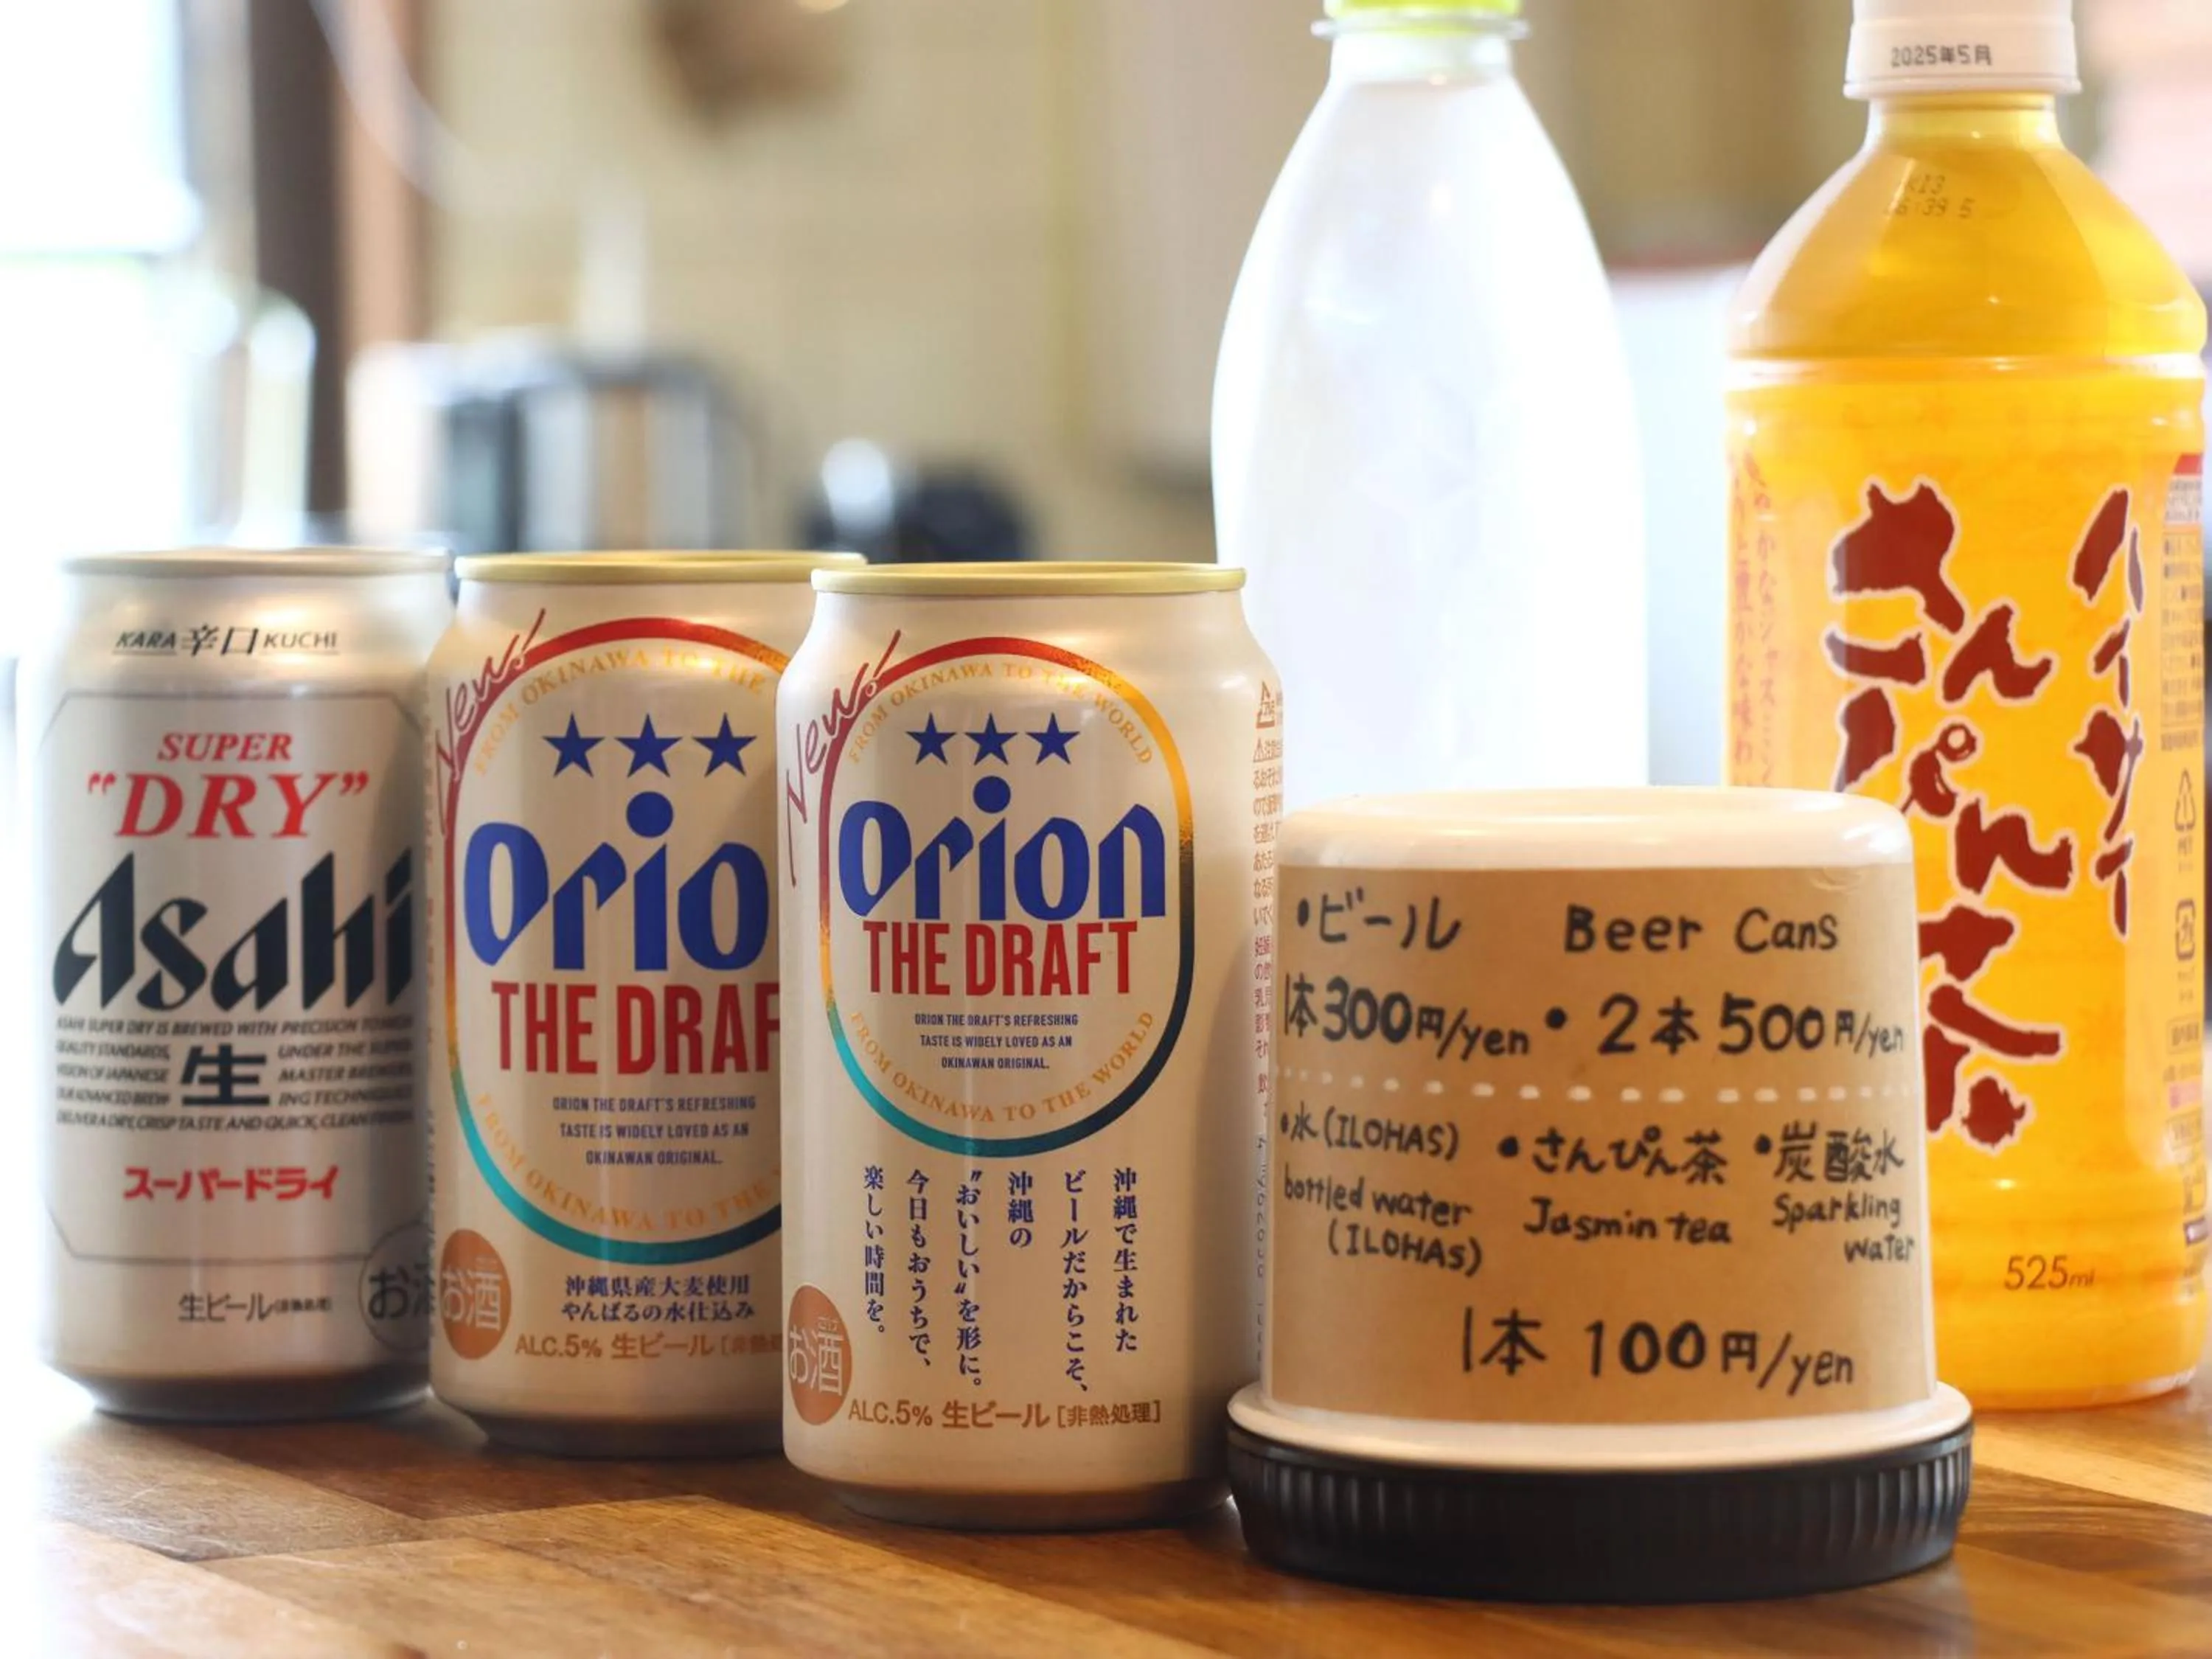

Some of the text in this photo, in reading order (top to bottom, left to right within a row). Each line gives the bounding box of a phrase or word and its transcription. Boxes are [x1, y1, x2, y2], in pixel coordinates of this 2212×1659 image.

[1891, 44, 1992, 68] 2025年5月
[113, 624, 338, 656] KARA 辛口 KUCHI
[521, 648, 650, 706] OKINAWA
[849, 704, 888, 765] FROM
[890, 662, 994, 706] OKINAWA
[1004, 662, 1032, 680] TO
[1093, 692, 1153, 765] WORLD
[157, 732, 293, 762] SUPER
[52, 846, 414, 1011] Asahi
[1318, 887, 1463, 950] ビール
[1563, 903, 1703, 953] Beer
[862, 919, 1138, 997] THE DRAFT
[171, 1020, 234, 1037] BREWED
[236, 1020, 279, 1036] WITH
[279, 1018, 358, 1034] PRECISION
[491, 981, 598, 1075] THE
[914, 1013, 1079, 1026] ORION THE DRAFT'S REFRESHING
[919, 1034, 1073, 1048] TASTE IS WIDELY LOVED AS AN
[179, 1043, 271, 1107] 生
[278, 1066, 346, 1083] MASTER
[850, 1012, 1154, 1122] FROM OKINAWA TO THE WORLD
[941, 1056, 1050, 1070] OKINAWAN ORIGINAL.
[225, 1116, 262, 1131] AND
[552, 1095, 757, 1113] ORION THE DRAFT'S REFRESHING
[560, 1121, 750, 1140] TASTE IS WIDELY LOVED AS AN
[1773, 1119, 1906, 1183] 炭酸水
[585, 1150, 724, 1166] OKINAWAN ORIGINAL.
[1531, 1124, 1729, 1186] さんぴん茶
[122, 1165, 341, 1202] スーパードライ
[526, 1168, 656, 1231] OKINAWA
[668, 1207, 706, 1230] TO
[711, 1181, 773, 1221] THE
[1284, 1161, 1473, 1228] bottled water
[1007, 1169, 1034, 1248] 沖縄の
[1523, 1194, 1732, 1245] Jasmin tea
[1772, 1190, 1902, 1236] Sparkling
[863, 1165, 886, 1333] 楽しい時間を。
[906, 1168, 932, 1368] 今日もおうちで、
[1113, 1166, 1138, 1354] 沖縄で生まれた
[1843, 1233, 1916, 1264] water
[566, 1274, 751, 1298] 沖縄県産大麦使用
[1060, 1169, 1089, 1393] ビールだからこそ、
[2004, 1254, 2096, 1292] 525ml
[560, 1299, 756, 1324] やんばるの水仕込み
[515, 1333, 603, 1359] ALC.5%
[789, 1324, 844, 1397] お酒
[847, 1399, 933, 1427] ALC.5%
[941, 1399, 1051, 1430] 生ビール
